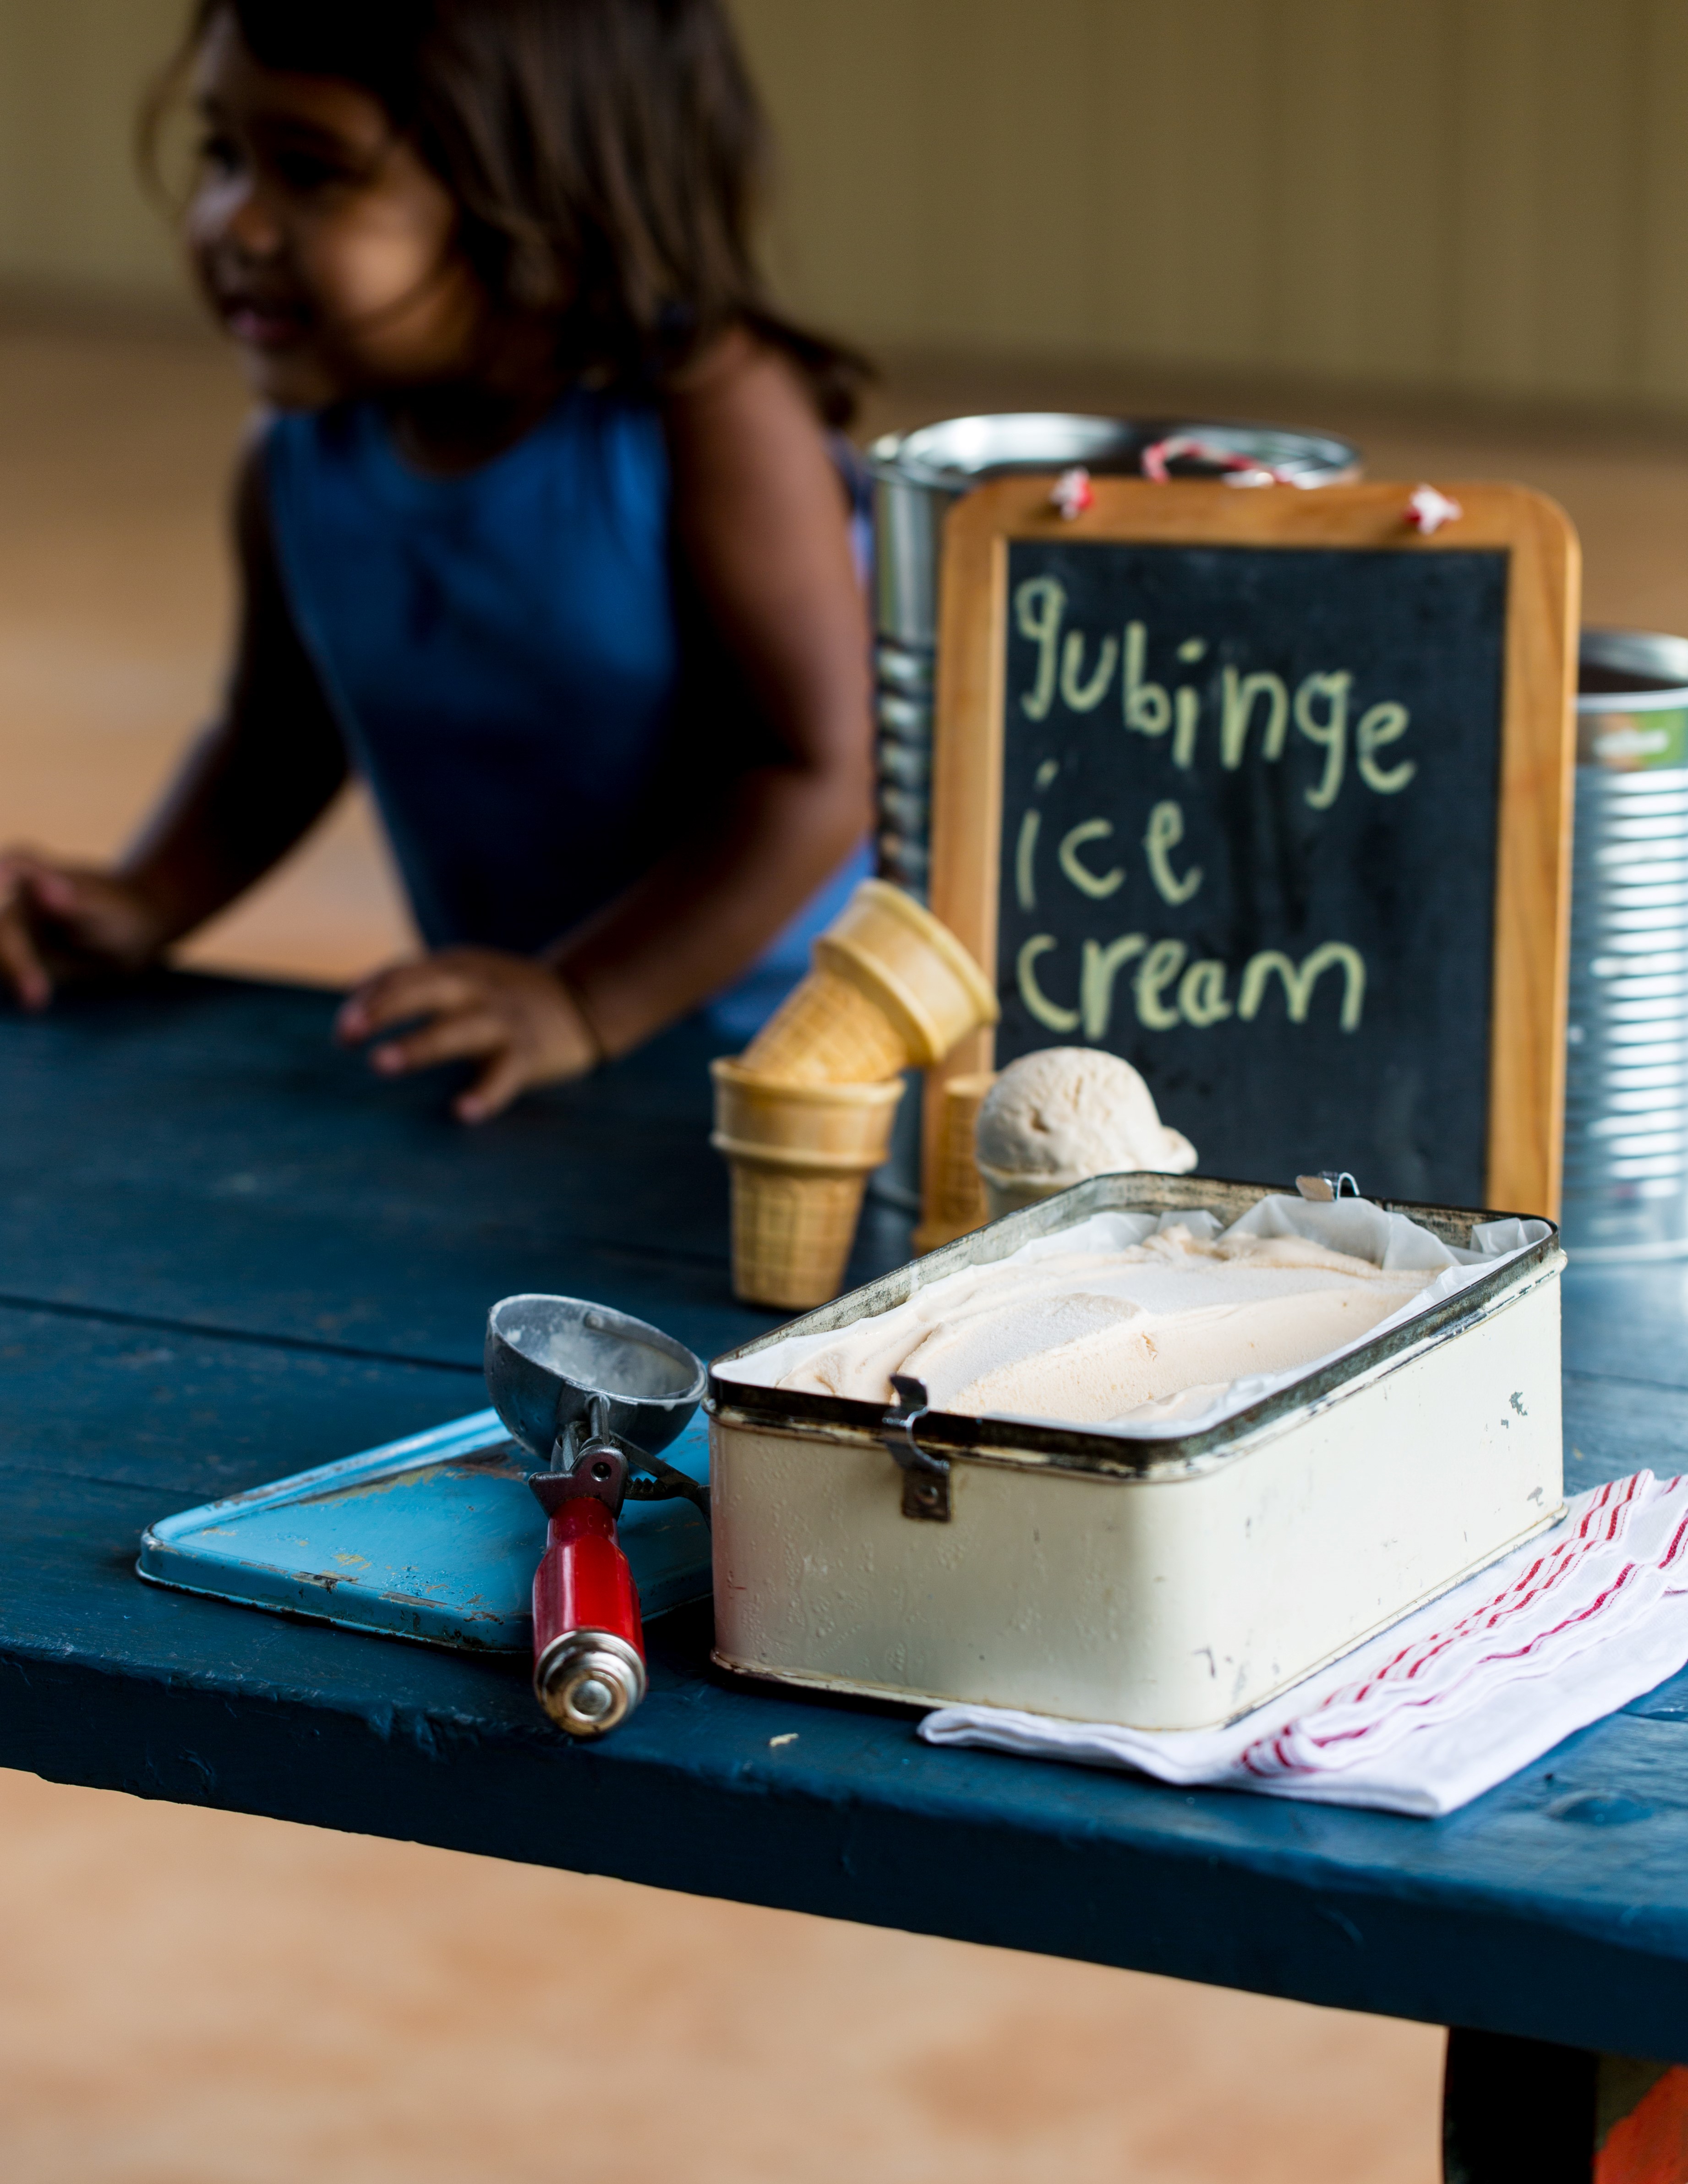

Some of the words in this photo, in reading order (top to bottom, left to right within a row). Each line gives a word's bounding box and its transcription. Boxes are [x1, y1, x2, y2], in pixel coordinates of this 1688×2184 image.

[1014, 575, 1415, 809] gubinge
[1016, 759, 1203, 910] ice
[1017, 934, 1365, 1040] cream
